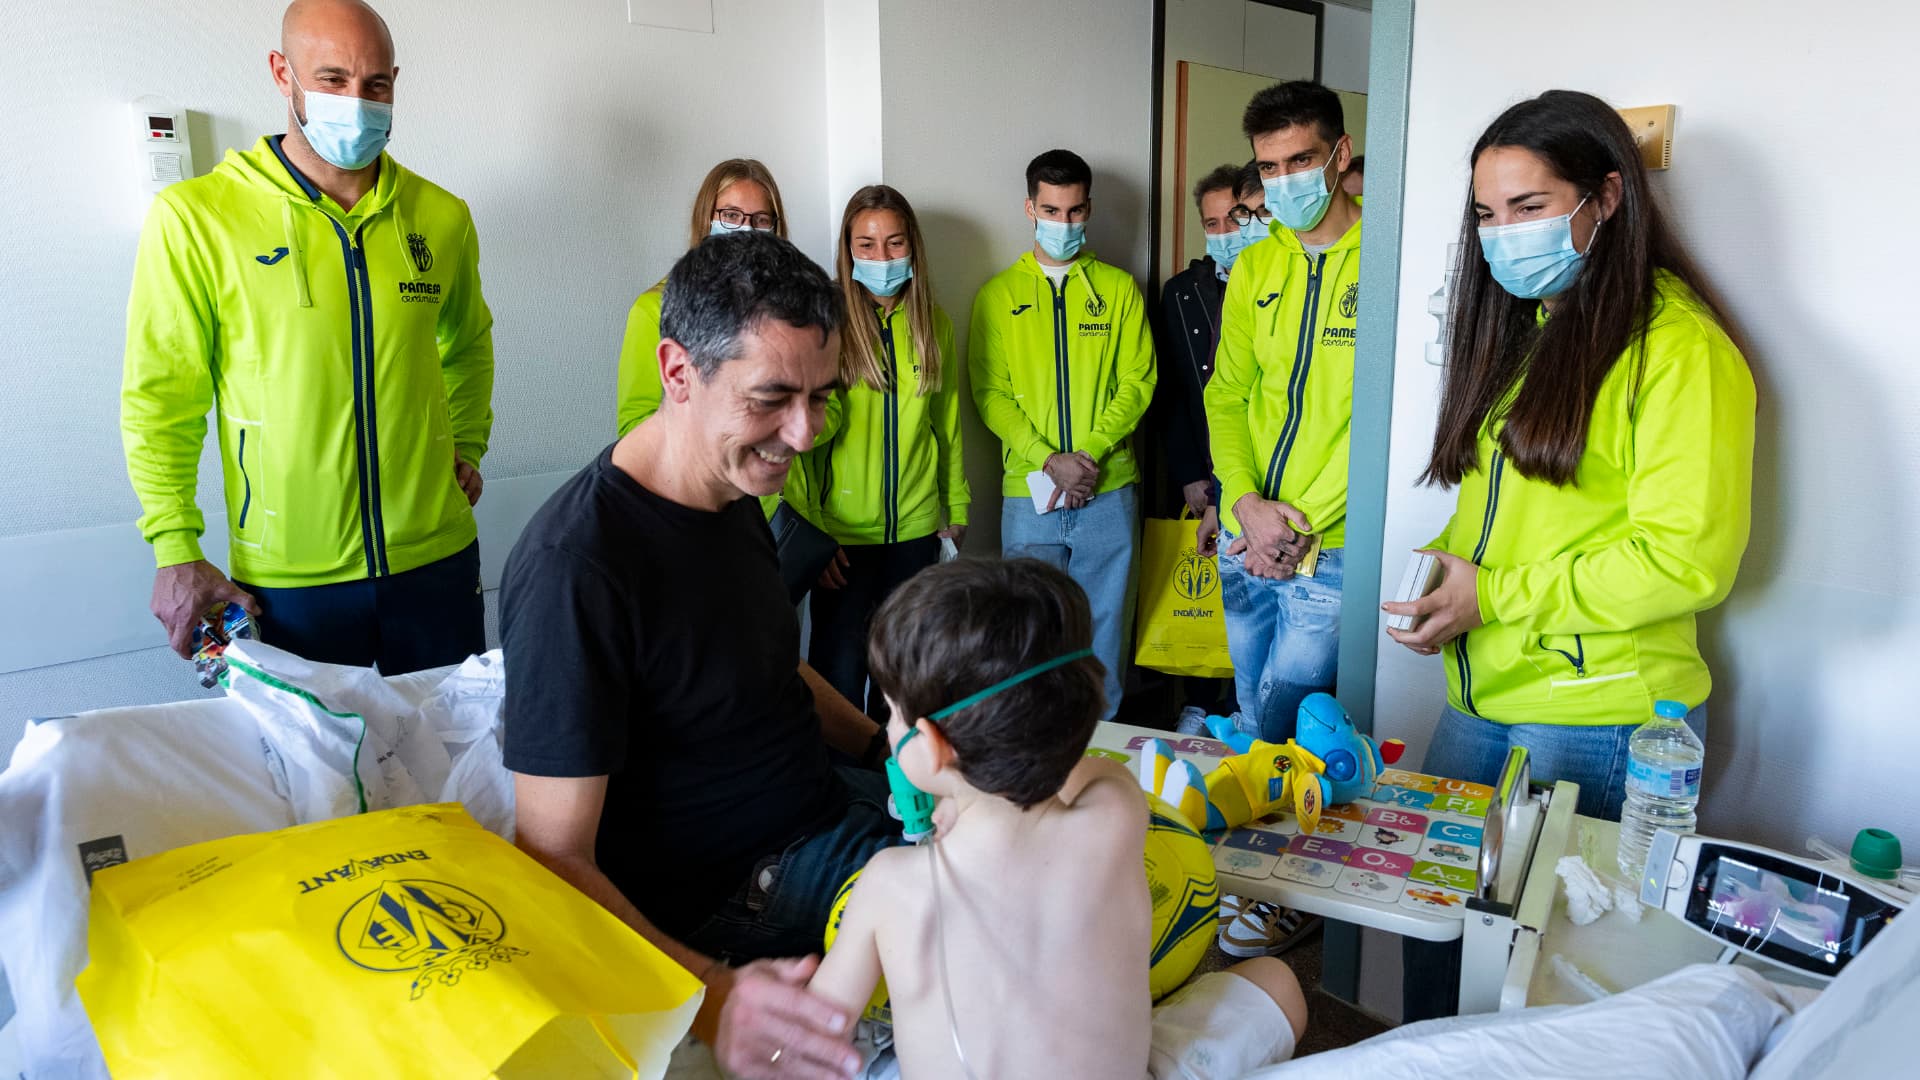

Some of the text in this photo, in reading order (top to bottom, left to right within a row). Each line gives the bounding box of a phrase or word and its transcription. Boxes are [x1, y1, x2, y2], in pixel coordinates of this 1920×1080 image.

[398, 282, 440, 295] PAMESA
[1323, 327, 1356, 338] PAME
[1173, 607, 1214, 620] ENDAVANT
[297, 849, 432, 895] ENDAVANT
